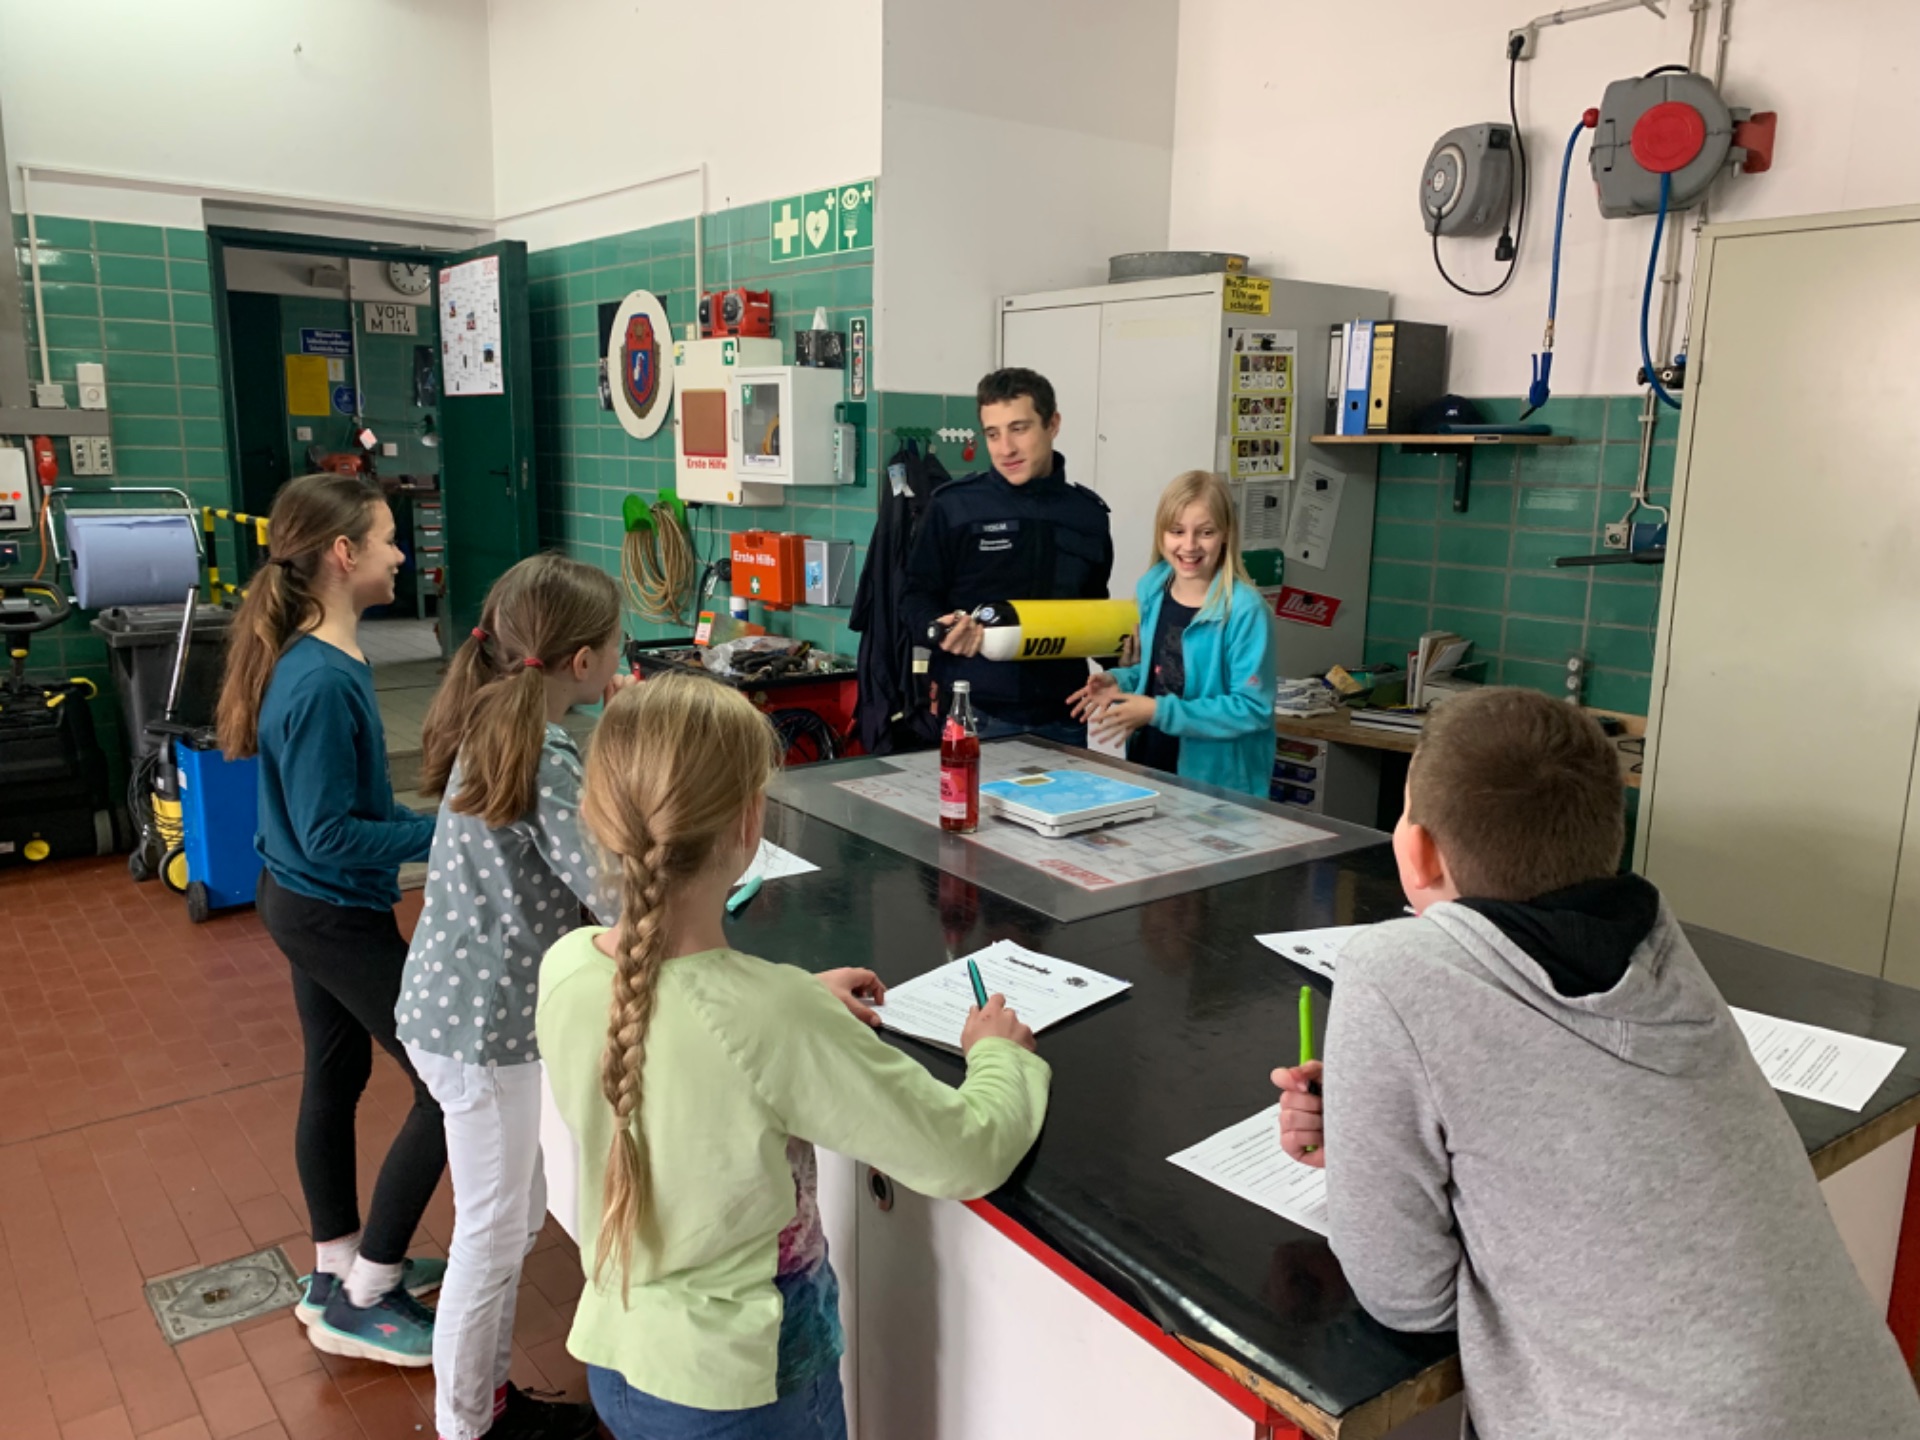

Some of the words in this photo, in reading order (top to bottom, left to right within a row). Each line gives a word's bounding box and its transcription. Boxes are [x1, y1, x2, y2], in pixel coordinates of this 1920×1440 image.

[375, 304, 406, 319] VOH
[371, 319, 383, 332] M
[391, 320, 410, 333] 114
[687, 458, 706, 469] Erste
[708, 459, 727, 470] Hilfe
[733, 550, 754, 564] Erste
[756, 553, 776, 567] Hilfe
[1022, 636, 1067, 656] VOH
